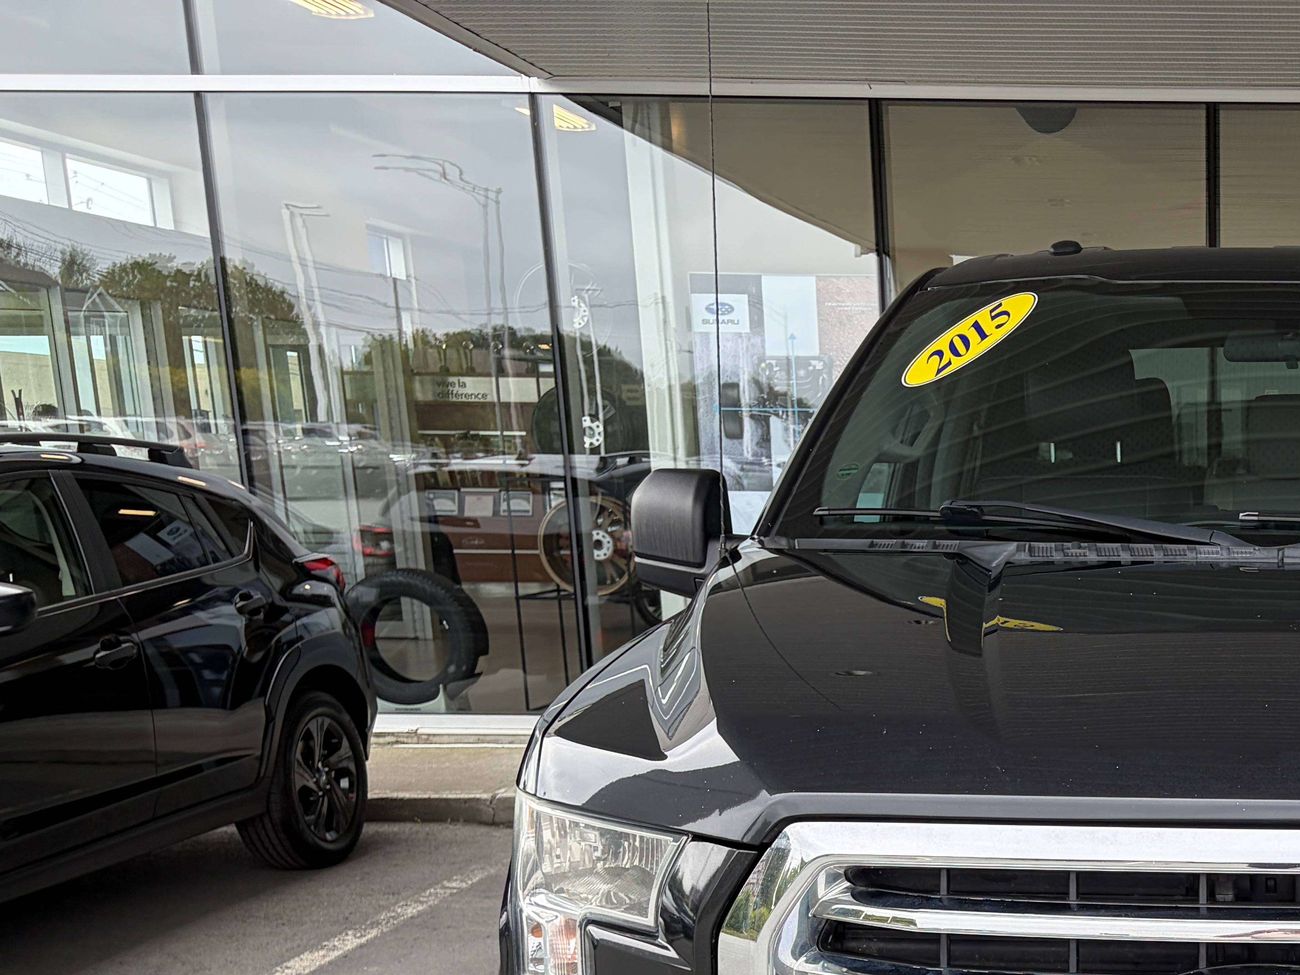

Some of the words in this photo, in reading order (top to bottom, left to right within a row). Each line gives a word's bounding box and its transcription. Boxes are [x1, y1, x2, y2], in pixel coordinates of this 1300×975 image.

[701, 318, 740, 326] SUARU
[926, 302, 1011, 377] 2015
[457, 378, 467, 389] la
